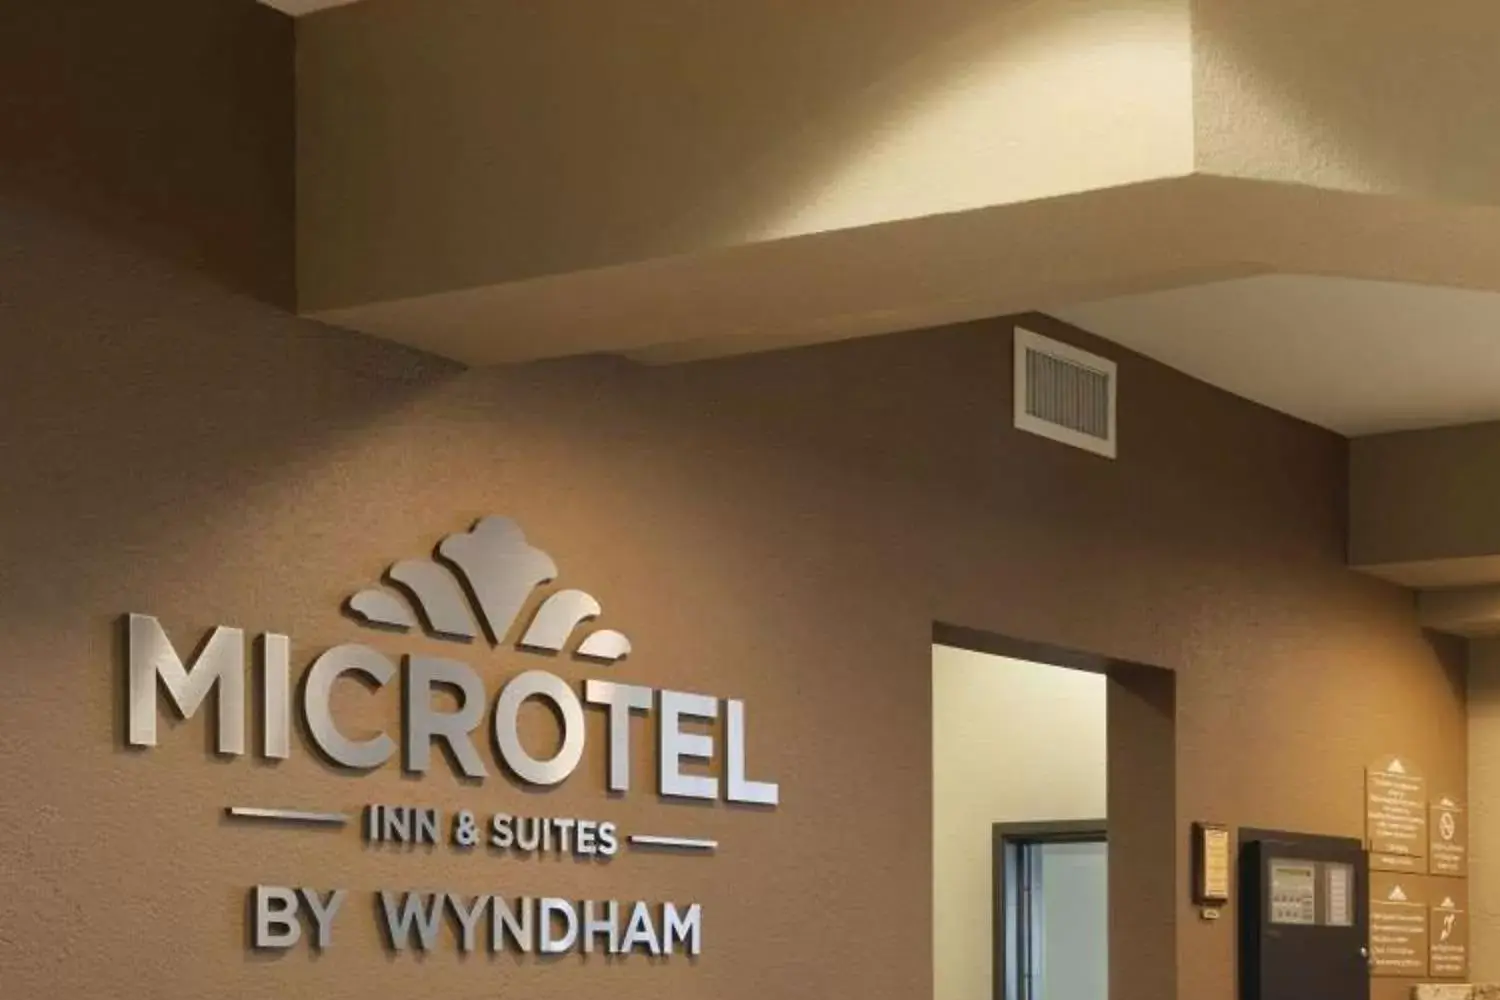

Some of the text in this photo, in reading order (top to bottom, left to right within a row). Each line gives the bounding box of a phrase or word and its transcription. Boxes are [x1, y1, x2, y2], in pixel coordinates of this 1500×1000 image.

[126, 611, 779, 806] MICROTEL
[367, 803, 619, 855] INN & SUITES
[254, 884, 701, 955] BY WYNDHAM
